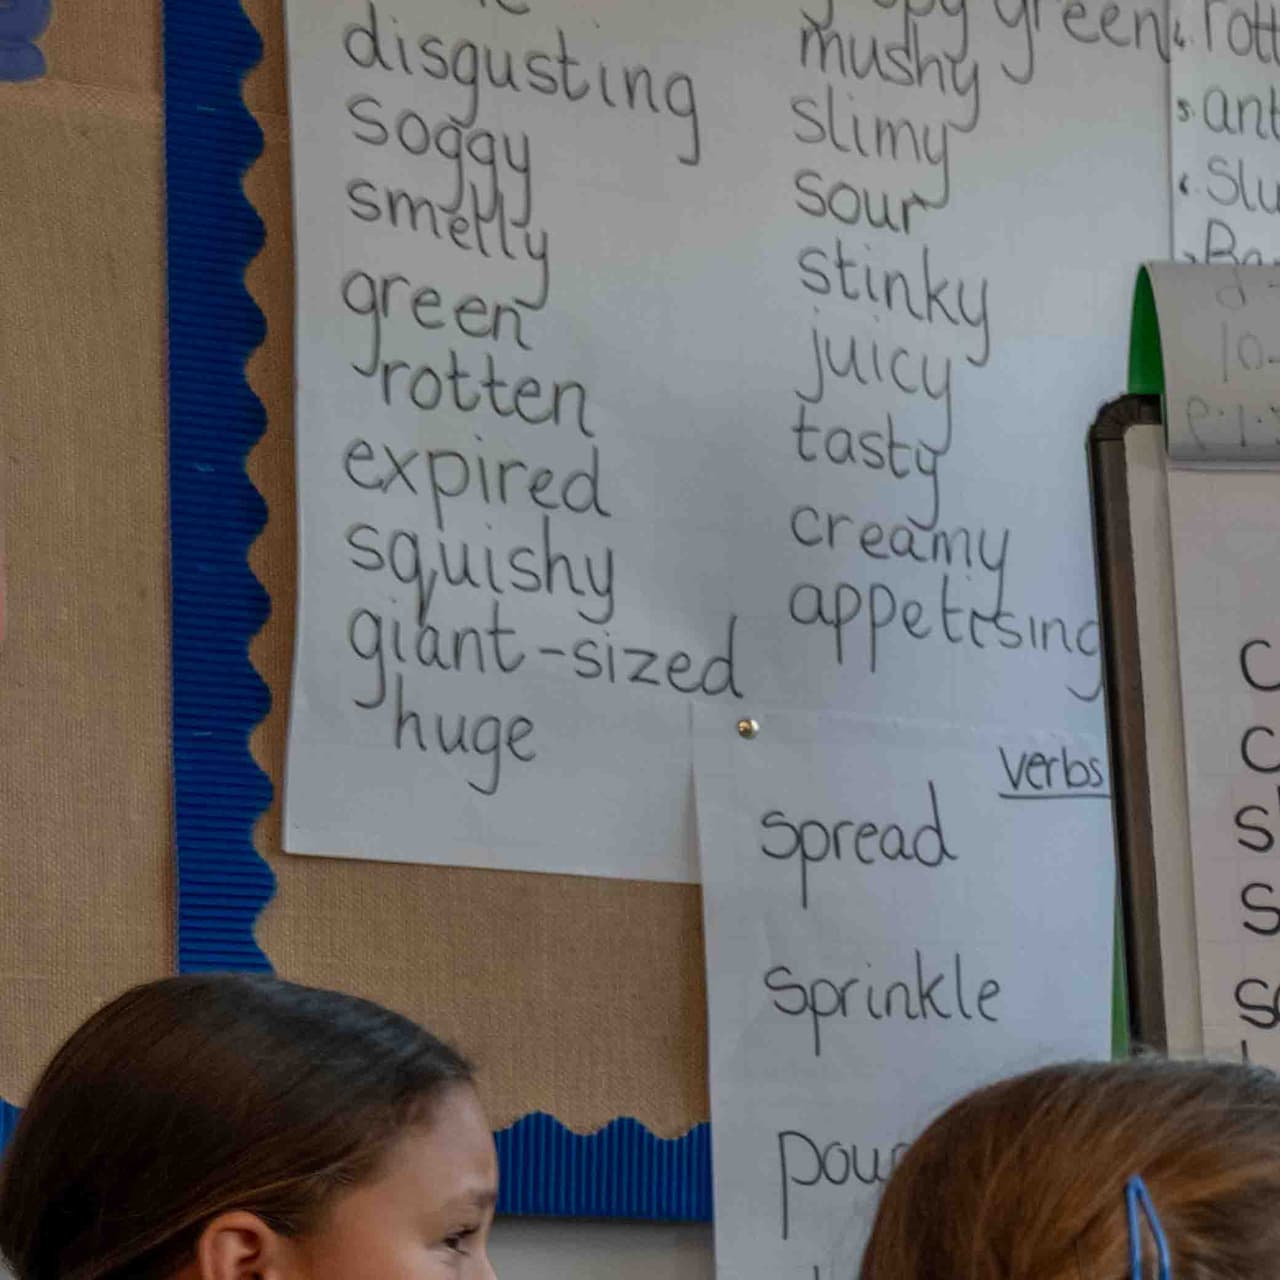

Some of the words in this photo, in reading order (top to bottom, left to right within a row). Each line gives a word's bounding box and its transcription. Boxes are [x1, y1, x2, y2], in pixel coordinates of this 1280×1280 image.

[343, 0, 701, 167] disgusting
[800, 20, 980, 133] mushy
[346, 95, 532, 228] soggy
[791, 82, 950, 210] slimy
[794, 168, 932, 235] sour
[346, 178, 549, 311] smelly
[797, 236, 990, 368] stinky
[341, 269, 533, 377] green
[795, 306, 952, 456] juicy
[380, 349, 597, 438] rotten
[342, 432, 612, 531] expired
[791, 404, 940, 531] tasty
[346, 513, 616, 628] squishy
[790, 504, 1011, 622] creamy
[348, 598, 745, 710] giant-sized
[393, 671, 537, 797] huge
[760, 779, 959, 910] spread
[763, 948, 1002, 1057] sprinkle
